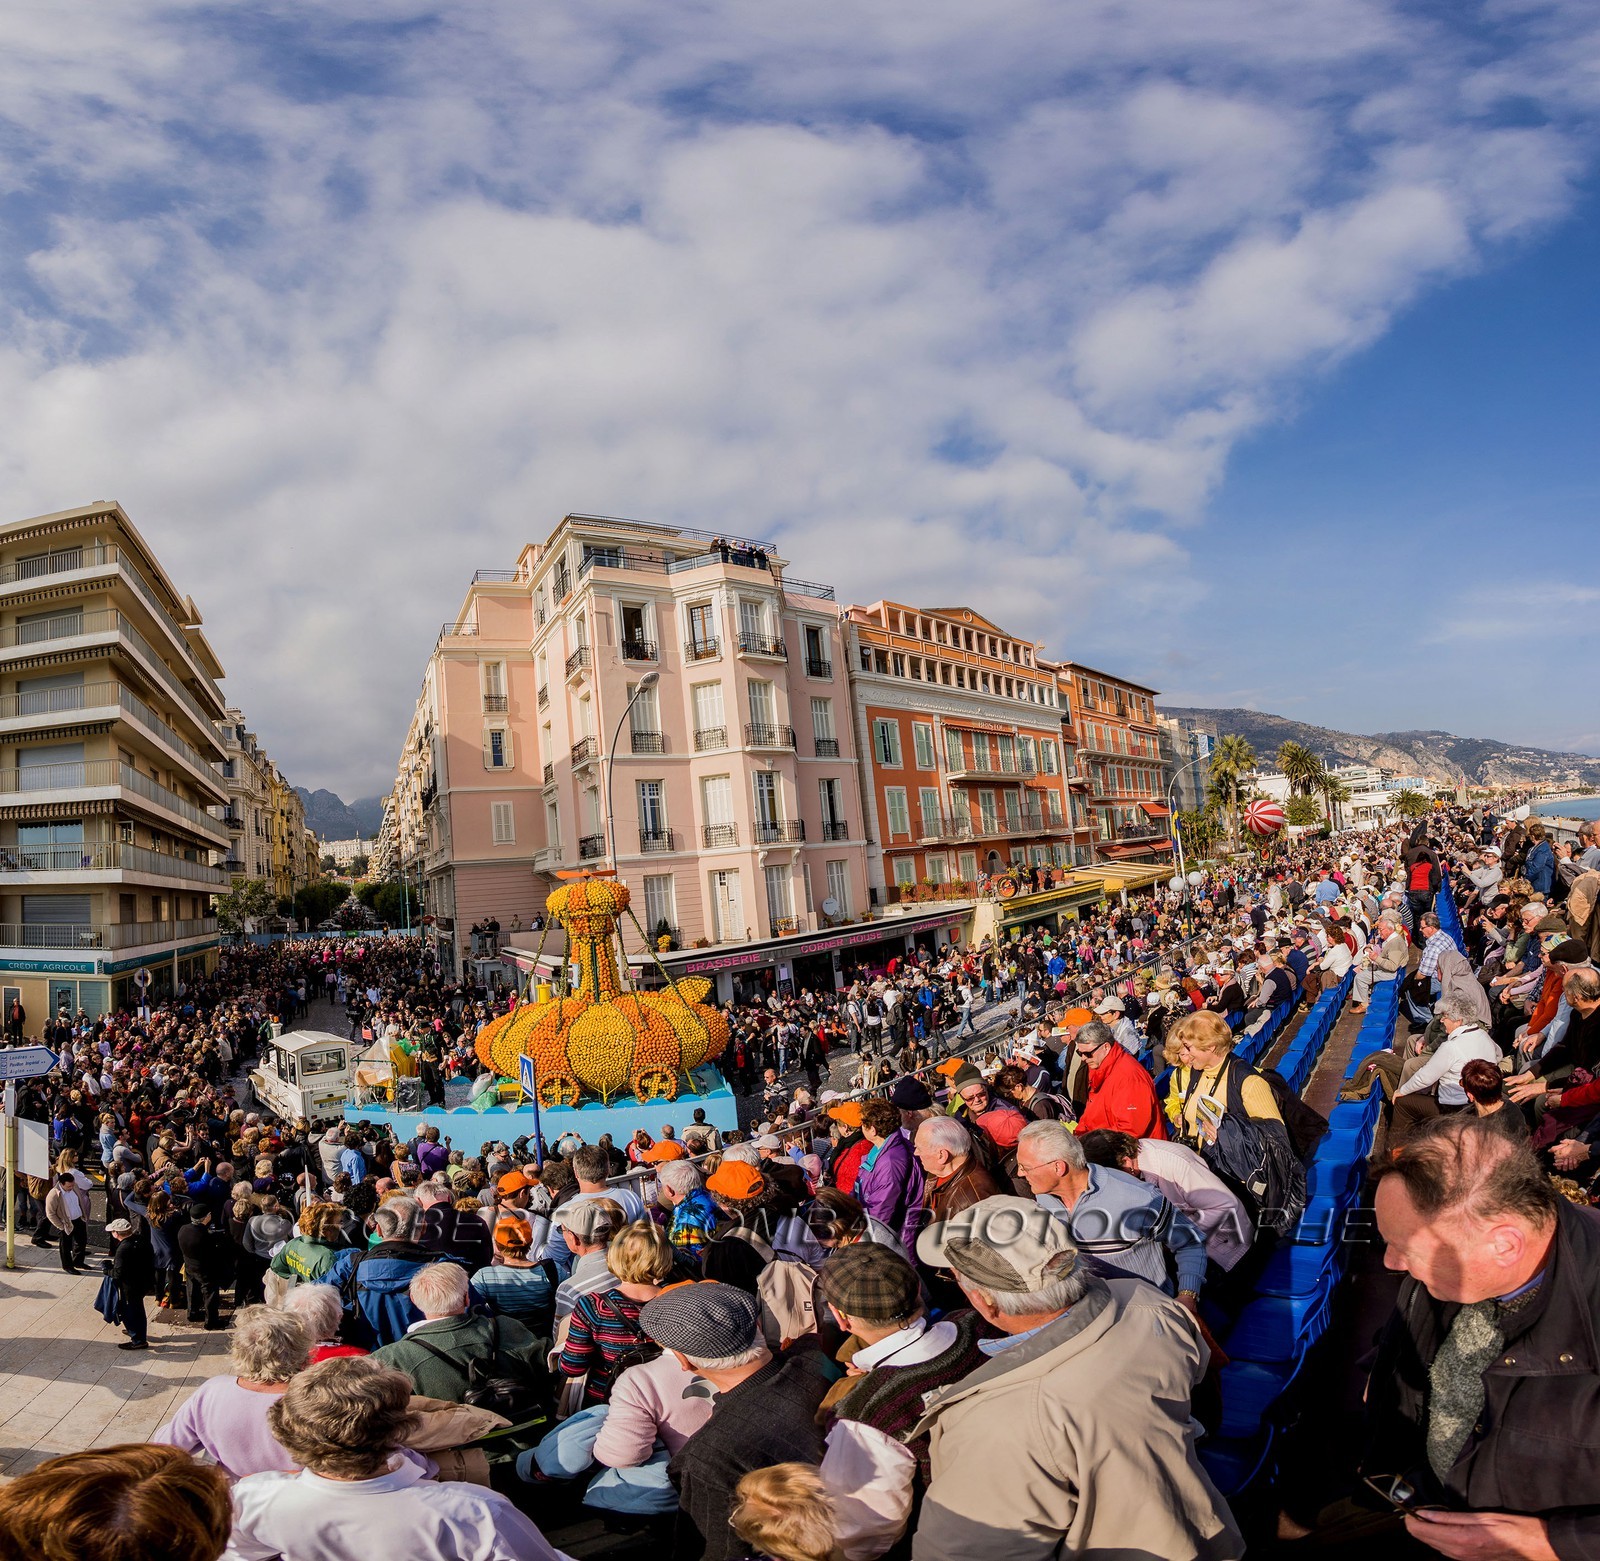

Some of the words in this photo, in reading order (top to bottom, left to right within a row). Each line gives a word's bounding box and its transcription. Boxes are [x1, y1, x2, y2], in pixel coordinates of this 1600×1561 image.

[946, 914, 963, 925] BAR
[801, 938, 844, 954] CORNER
[849, 931, 883, 945] HOUSE
[42, 963, 87, 972] AGRICOLE
[686, 953, 761, 973] BRASSERIE
